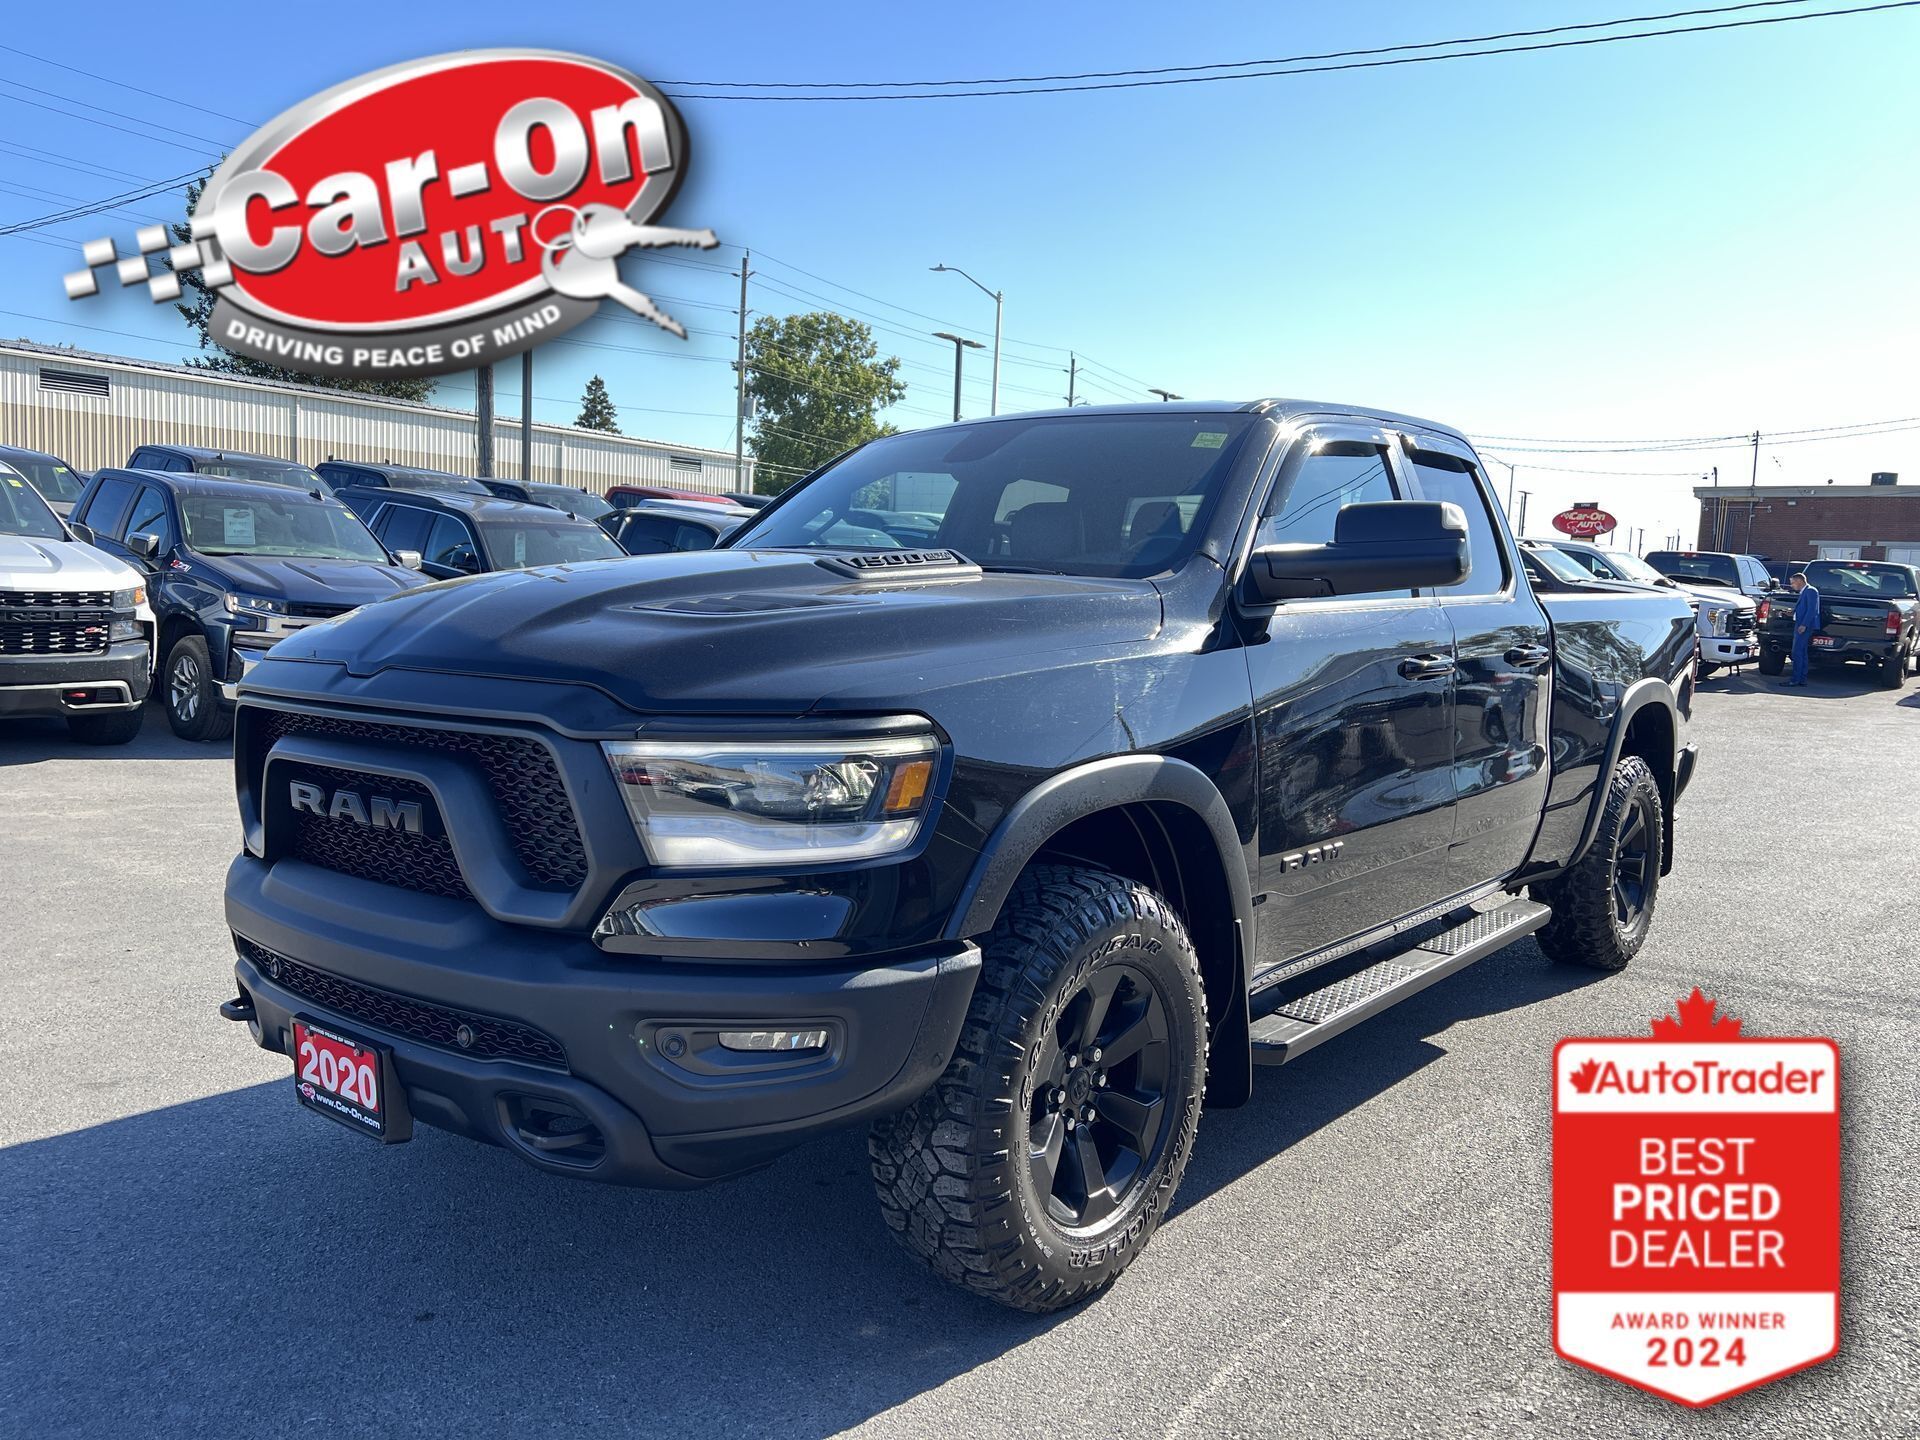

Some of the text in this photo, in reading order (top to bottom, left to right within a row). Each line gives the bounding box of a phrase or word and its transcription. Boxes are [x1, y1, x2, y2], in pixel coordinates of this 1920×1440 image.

[851, 552, 924, 568] 1500
[290, 780, 423, 837] RAM
[1280, 841, 1344, 873] RAM
[1021, 933, 1163, 1111] GOODYEAR
[300, 1041, 377, 1110] 2020
[315, 1093, 381, 1129] www.Car-On.com
[1068, 1095, 1197, 1269] WRANGLER
